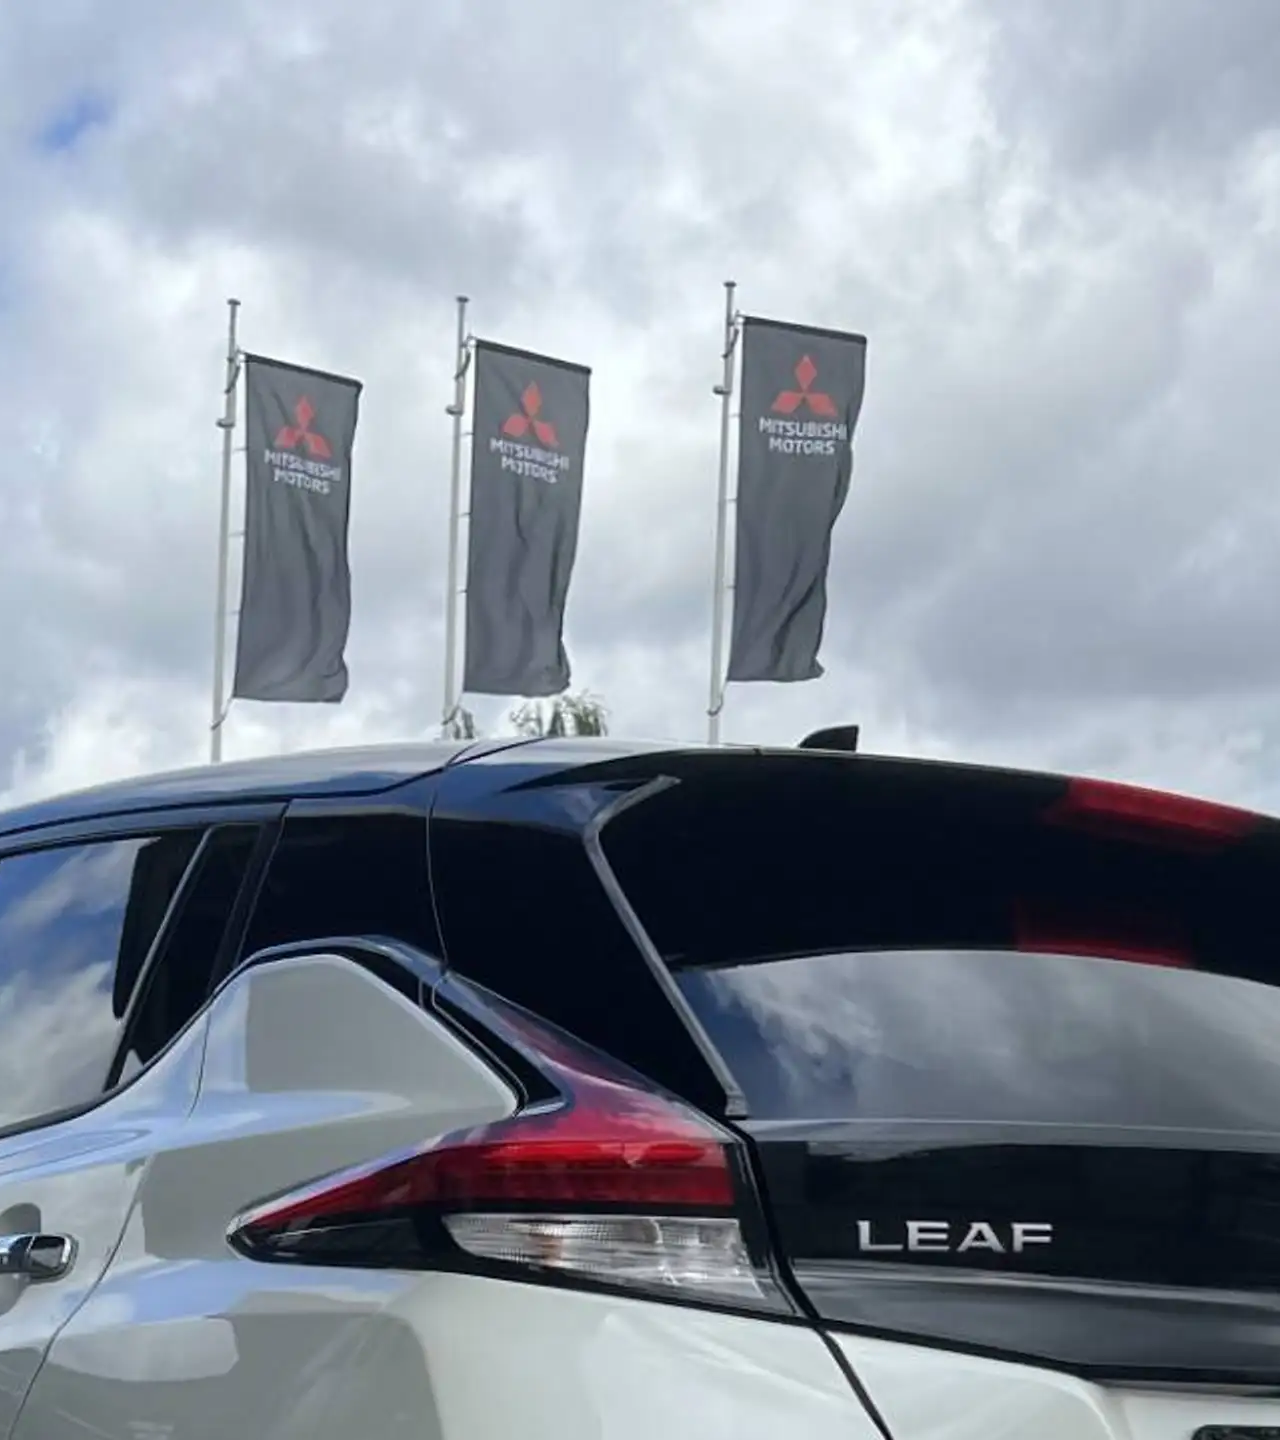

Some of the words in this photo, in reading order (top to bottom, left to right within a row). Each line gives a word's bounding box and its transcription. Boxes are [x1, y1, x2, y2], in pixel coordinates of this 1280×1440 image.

[759, 417, 848, 440] MITSUBISHI
[489, 438, 570, 471] MITSUBISHI
[769, 437, 836, 455] MOTORS
[274, 467, 331, 495] MOTORS
[501, 456, 558, 484] MOTORS
[857, 1220, 1053, 1253] LEAF
